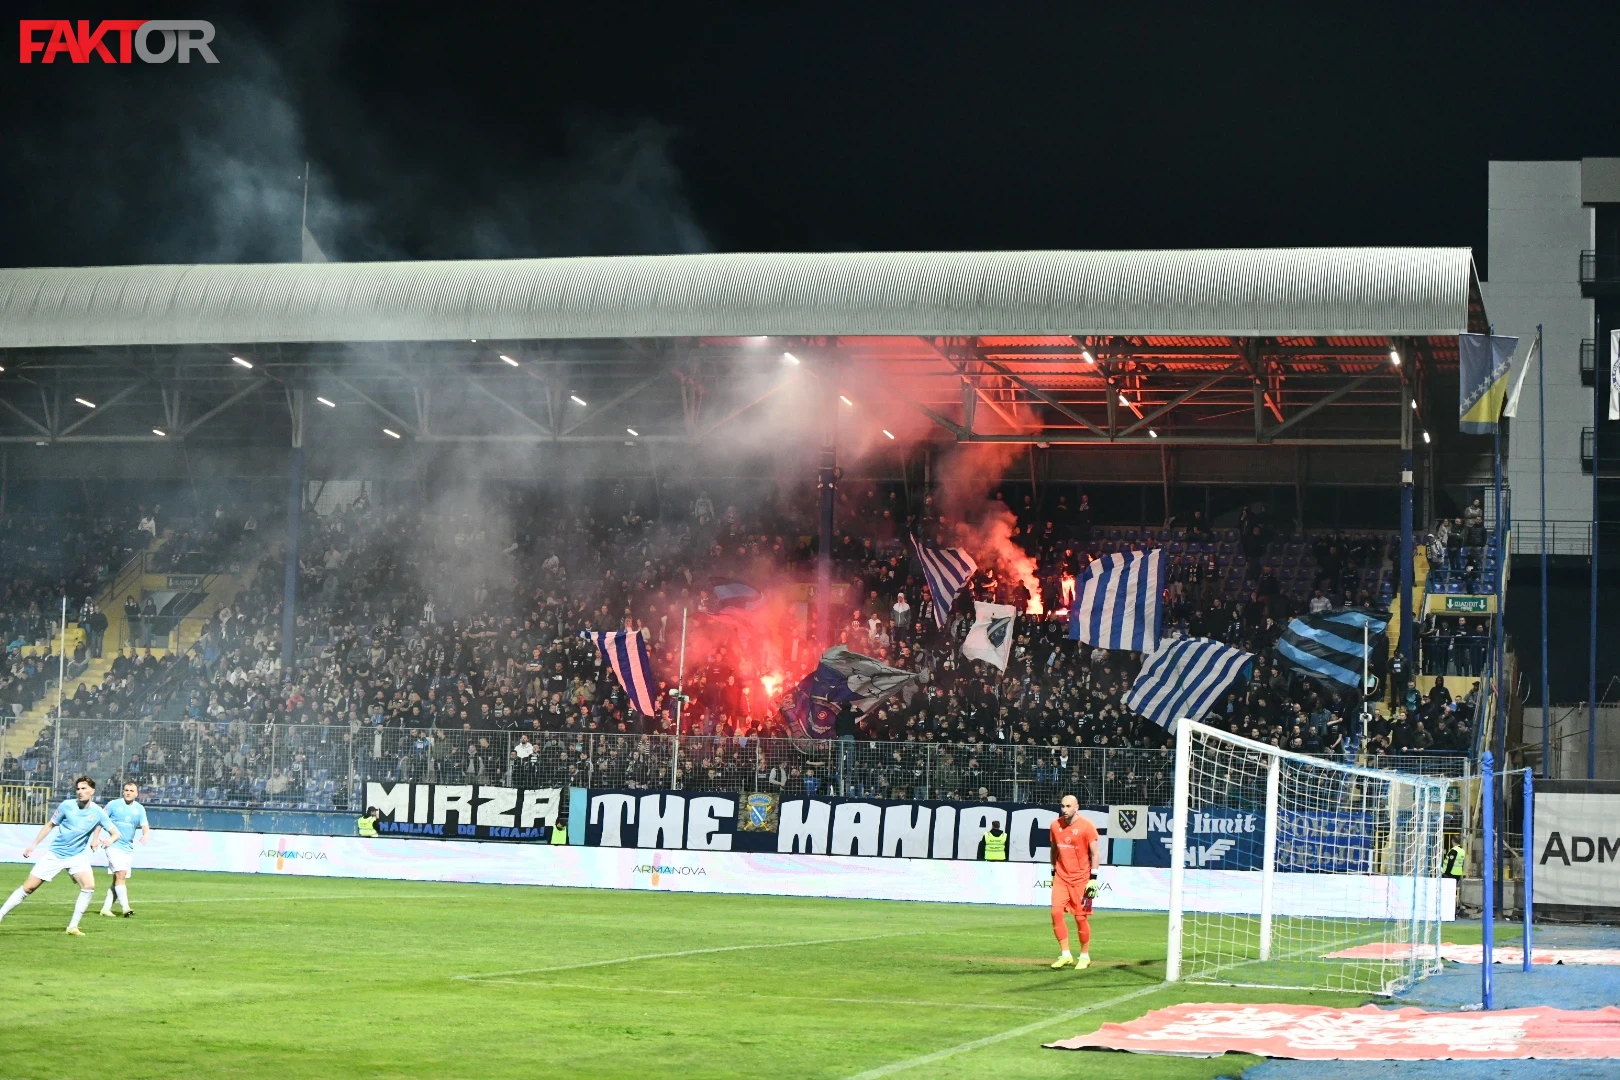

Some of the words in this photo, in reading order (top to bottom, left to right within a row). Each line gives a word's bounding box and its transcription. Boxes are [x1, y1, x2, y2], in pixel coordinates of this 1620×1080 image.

[366, 782, 562, 828] MIRZA
[379, 821, 444, 836] MANIJAK
[457, 825, 476, 836] DO
[489, 827, 545, 838] KRAJA!
[589, 793, 734, 851] THE
[777, 800, 1107, 862] MANIAC
[1193, 813, 1256, 833] limit
[259, 849, 328, 860] ARMANOVA
[632, 864, 707, 876] ARMANOVA
[1033, 880, 1113, 892] ARVA
